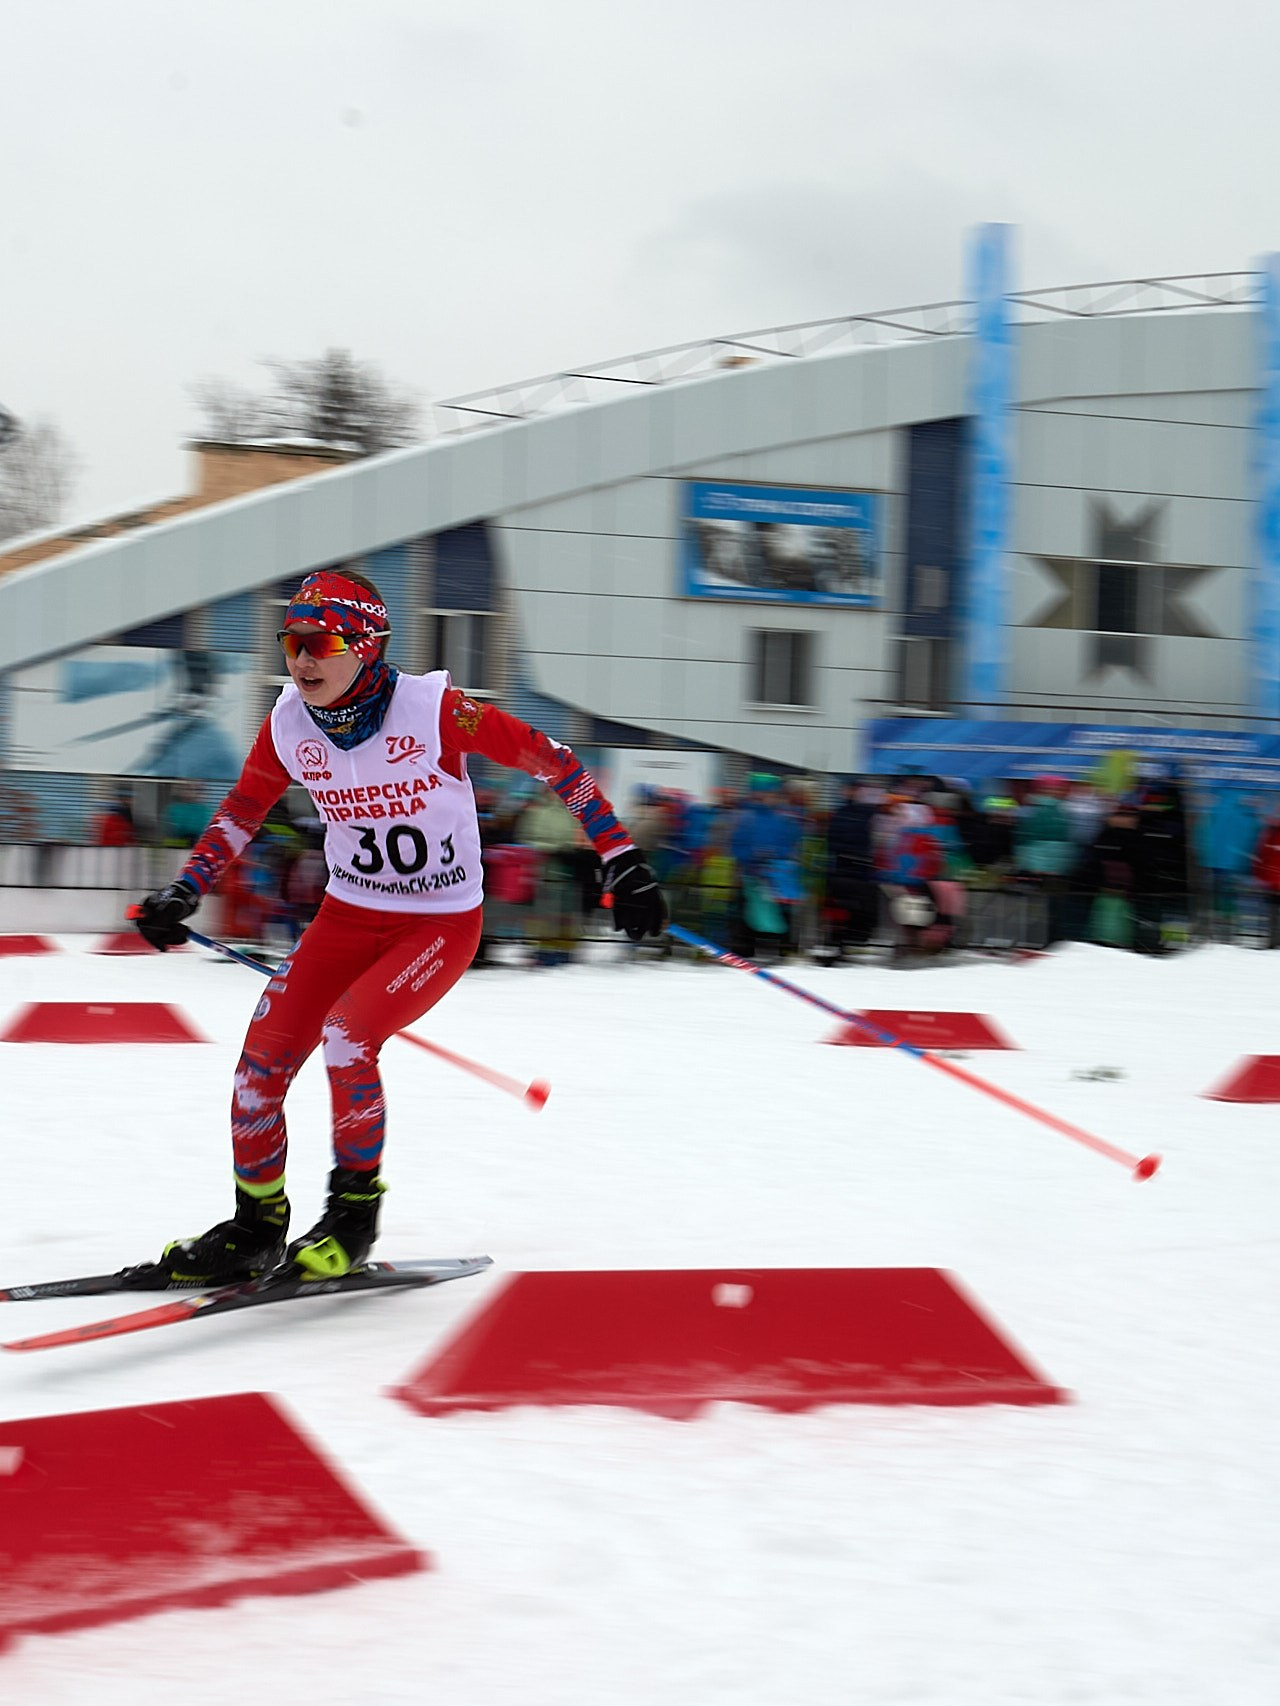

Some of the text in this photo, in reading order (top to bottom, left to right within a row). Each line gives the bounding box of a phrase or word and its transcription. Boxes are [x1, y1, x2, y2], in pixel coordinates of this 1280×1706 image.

[385, 736, 415, 754] 70
[302, 770, 332, 781] КПРФ
[323, 797, 427, 822] ПРАВДА
[349, 824, 428, 874] 30
